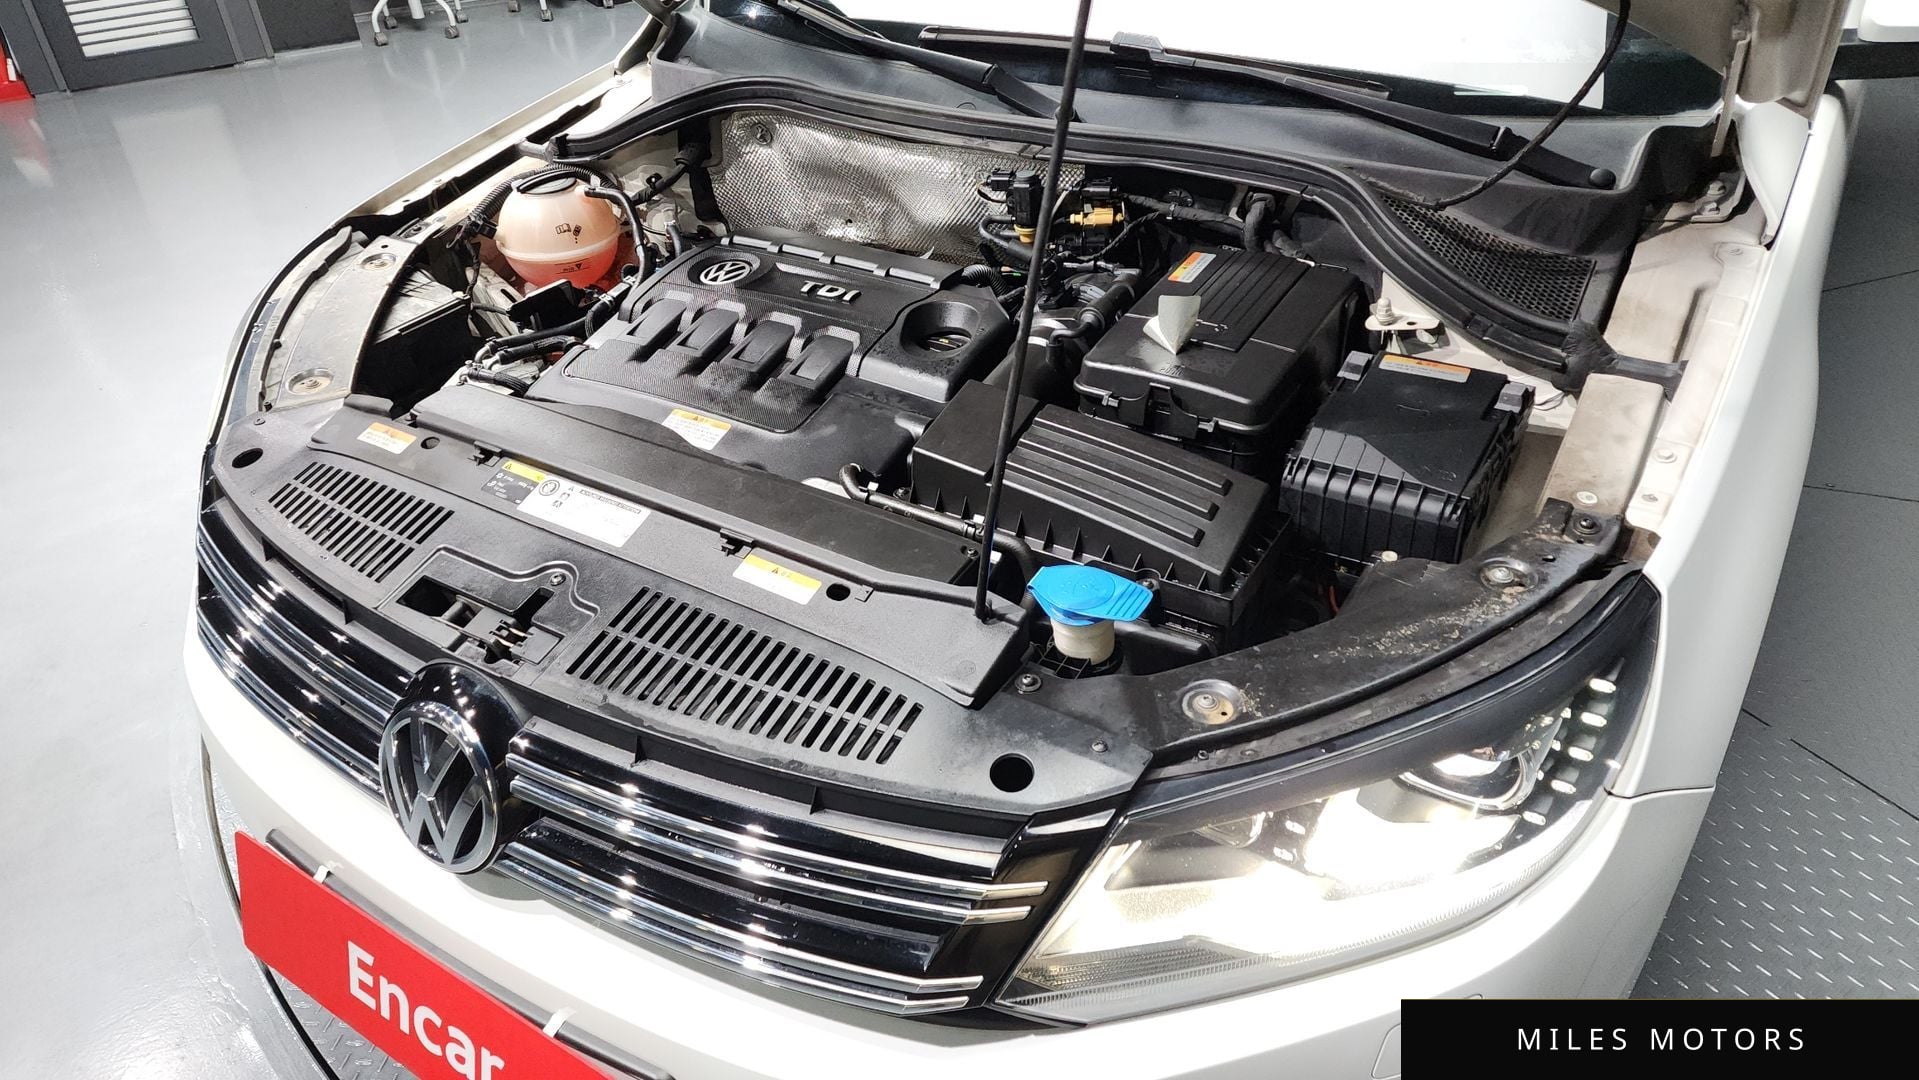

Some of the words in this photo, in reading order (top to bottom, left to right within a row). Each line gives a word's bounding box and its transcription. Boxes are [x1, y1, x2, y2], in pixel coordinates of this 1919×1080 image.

[800, 279, 862, 303] TDI
[384, 706, 498, 870] VW
[347, 940, 505, 1080] Encar
